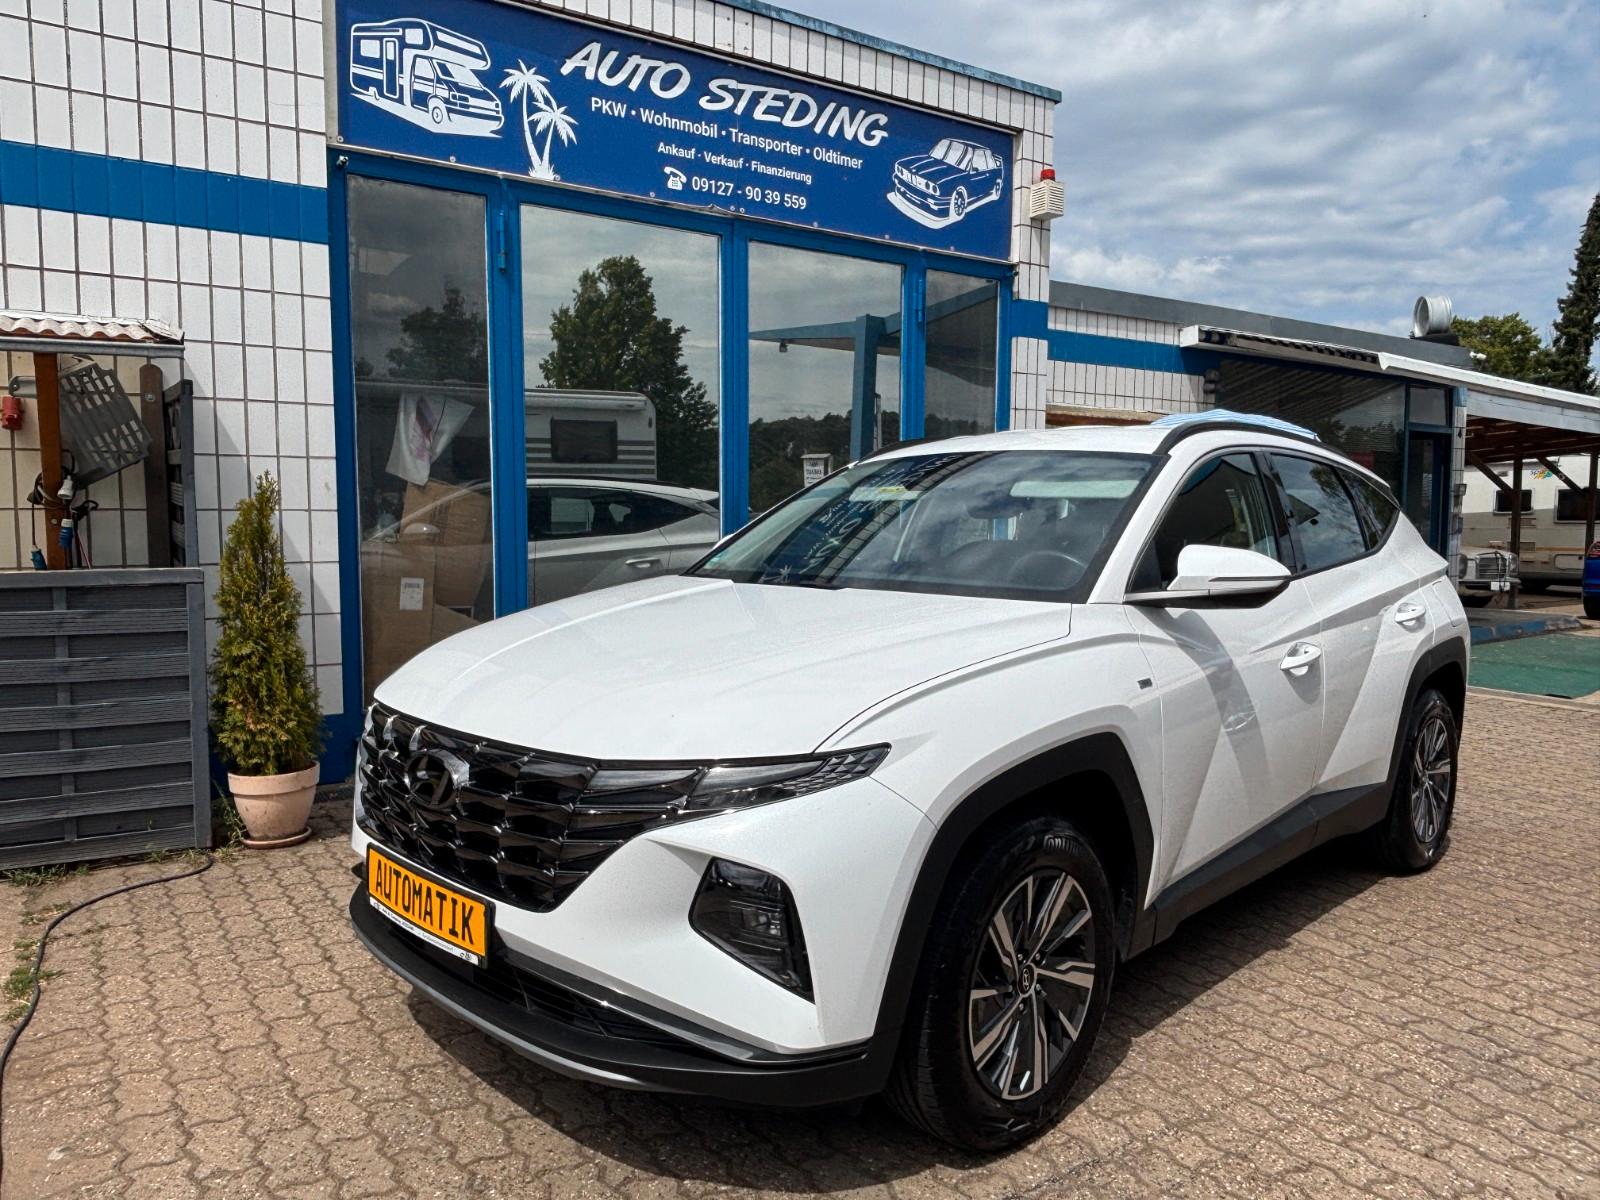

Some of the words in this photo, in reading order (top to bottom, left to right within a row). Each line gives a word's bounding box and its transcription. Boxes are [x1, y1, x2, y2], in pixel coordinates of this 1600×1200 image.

[560, 41, 691, 99] AUTO
[699, 78, 888, 147] STEDING
[591, 96, 627, 118] PKW
[640, 107, 718, 138] Wohnmobil
[729, 127, 803, 156] Transporter
[813, 146, 863, 169] Oldtimer
[657, 141, 696, 159] Ankauf
[704, 151, 744, 169] Verkauf
[751, 160, 812, 185] Finanzierung
[692, 176, 734, 197] 09127
[745, 186, 762, 201] 90
[764, 189, 781, 204] 39
[784, 194, 807, 210] 559
[376, 859, 474, 945] AUTOMATIK
